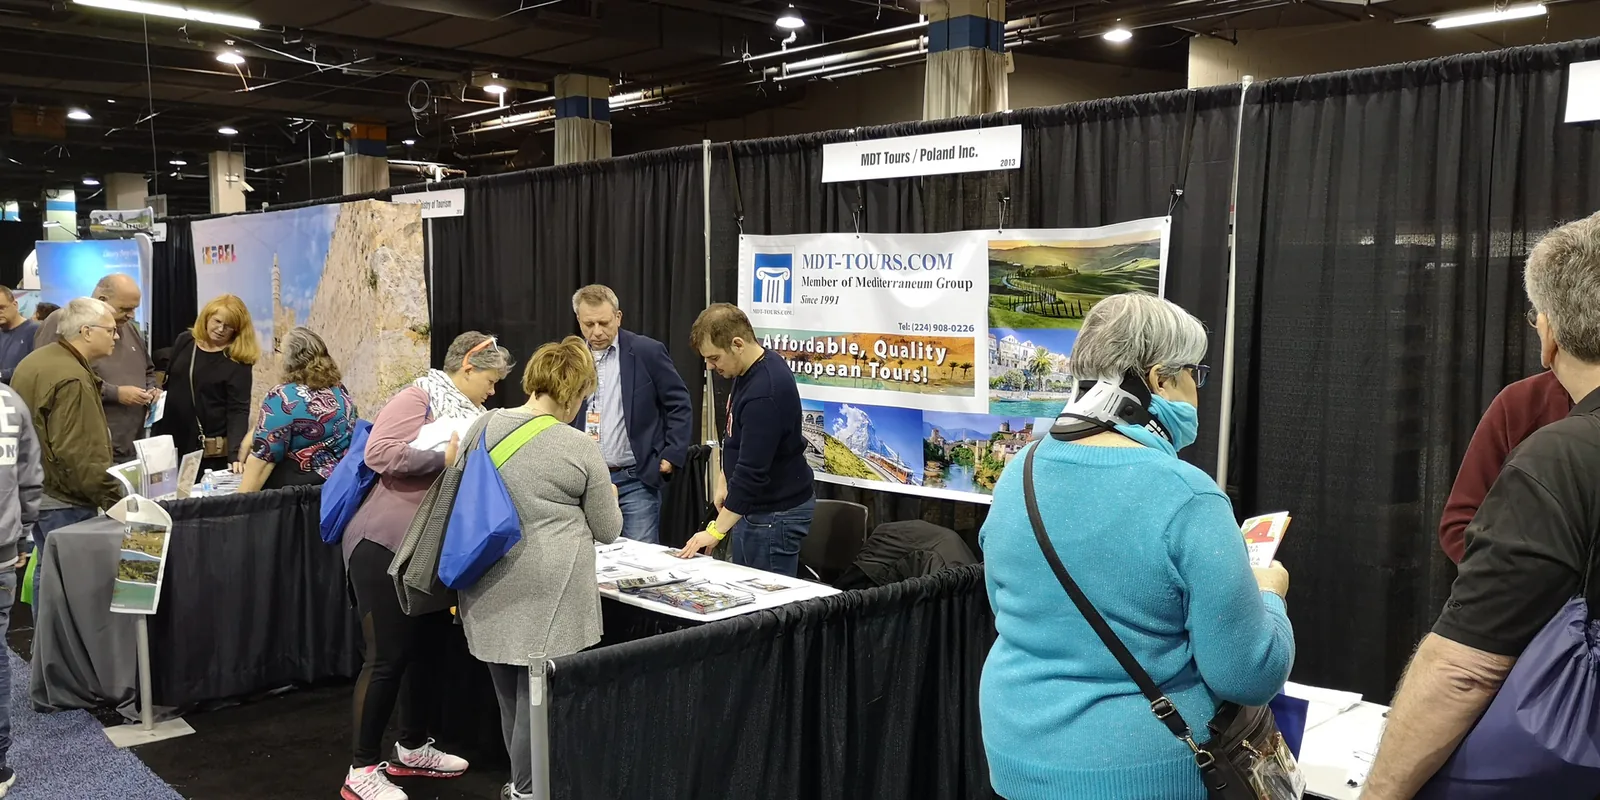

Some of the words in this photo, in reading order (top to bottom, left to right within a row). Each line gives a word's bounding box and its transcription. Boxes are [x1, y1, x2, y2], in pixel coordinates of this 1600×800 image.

[860, 152, 882, 166] MDT
[883, 151, 911, 165] Tours
[912, 149, 918, 164] /
[920, 146, 956, 162] Poland
[958, 146, 979, 159] Inc.
[1000, 158, 1016, 167] 2013
[436, 200, 451, 208] Tourism
[801, 253, 954, 271] MDT-TOURS.COM
[801, 275, 839, 289] Member
[841, 276, 852, 287] of
[855, 276, 933, 290] Mediterraneum
[936, 276, 974, 292] Group
[800, 294, 819, 306] Since
[820, 294, 840, 306] 1991
[898, 322, 911, 332] Tel:
[911, 322, 932, 333] (224)
[933, 324, 975, 333] 908-0226
[762, 333, 865, 357] Affordable,
[873, 339, 947, 366] Quality
[783, 355, 861, 379] uropean
[869, 361, 929, 384] Tours!
